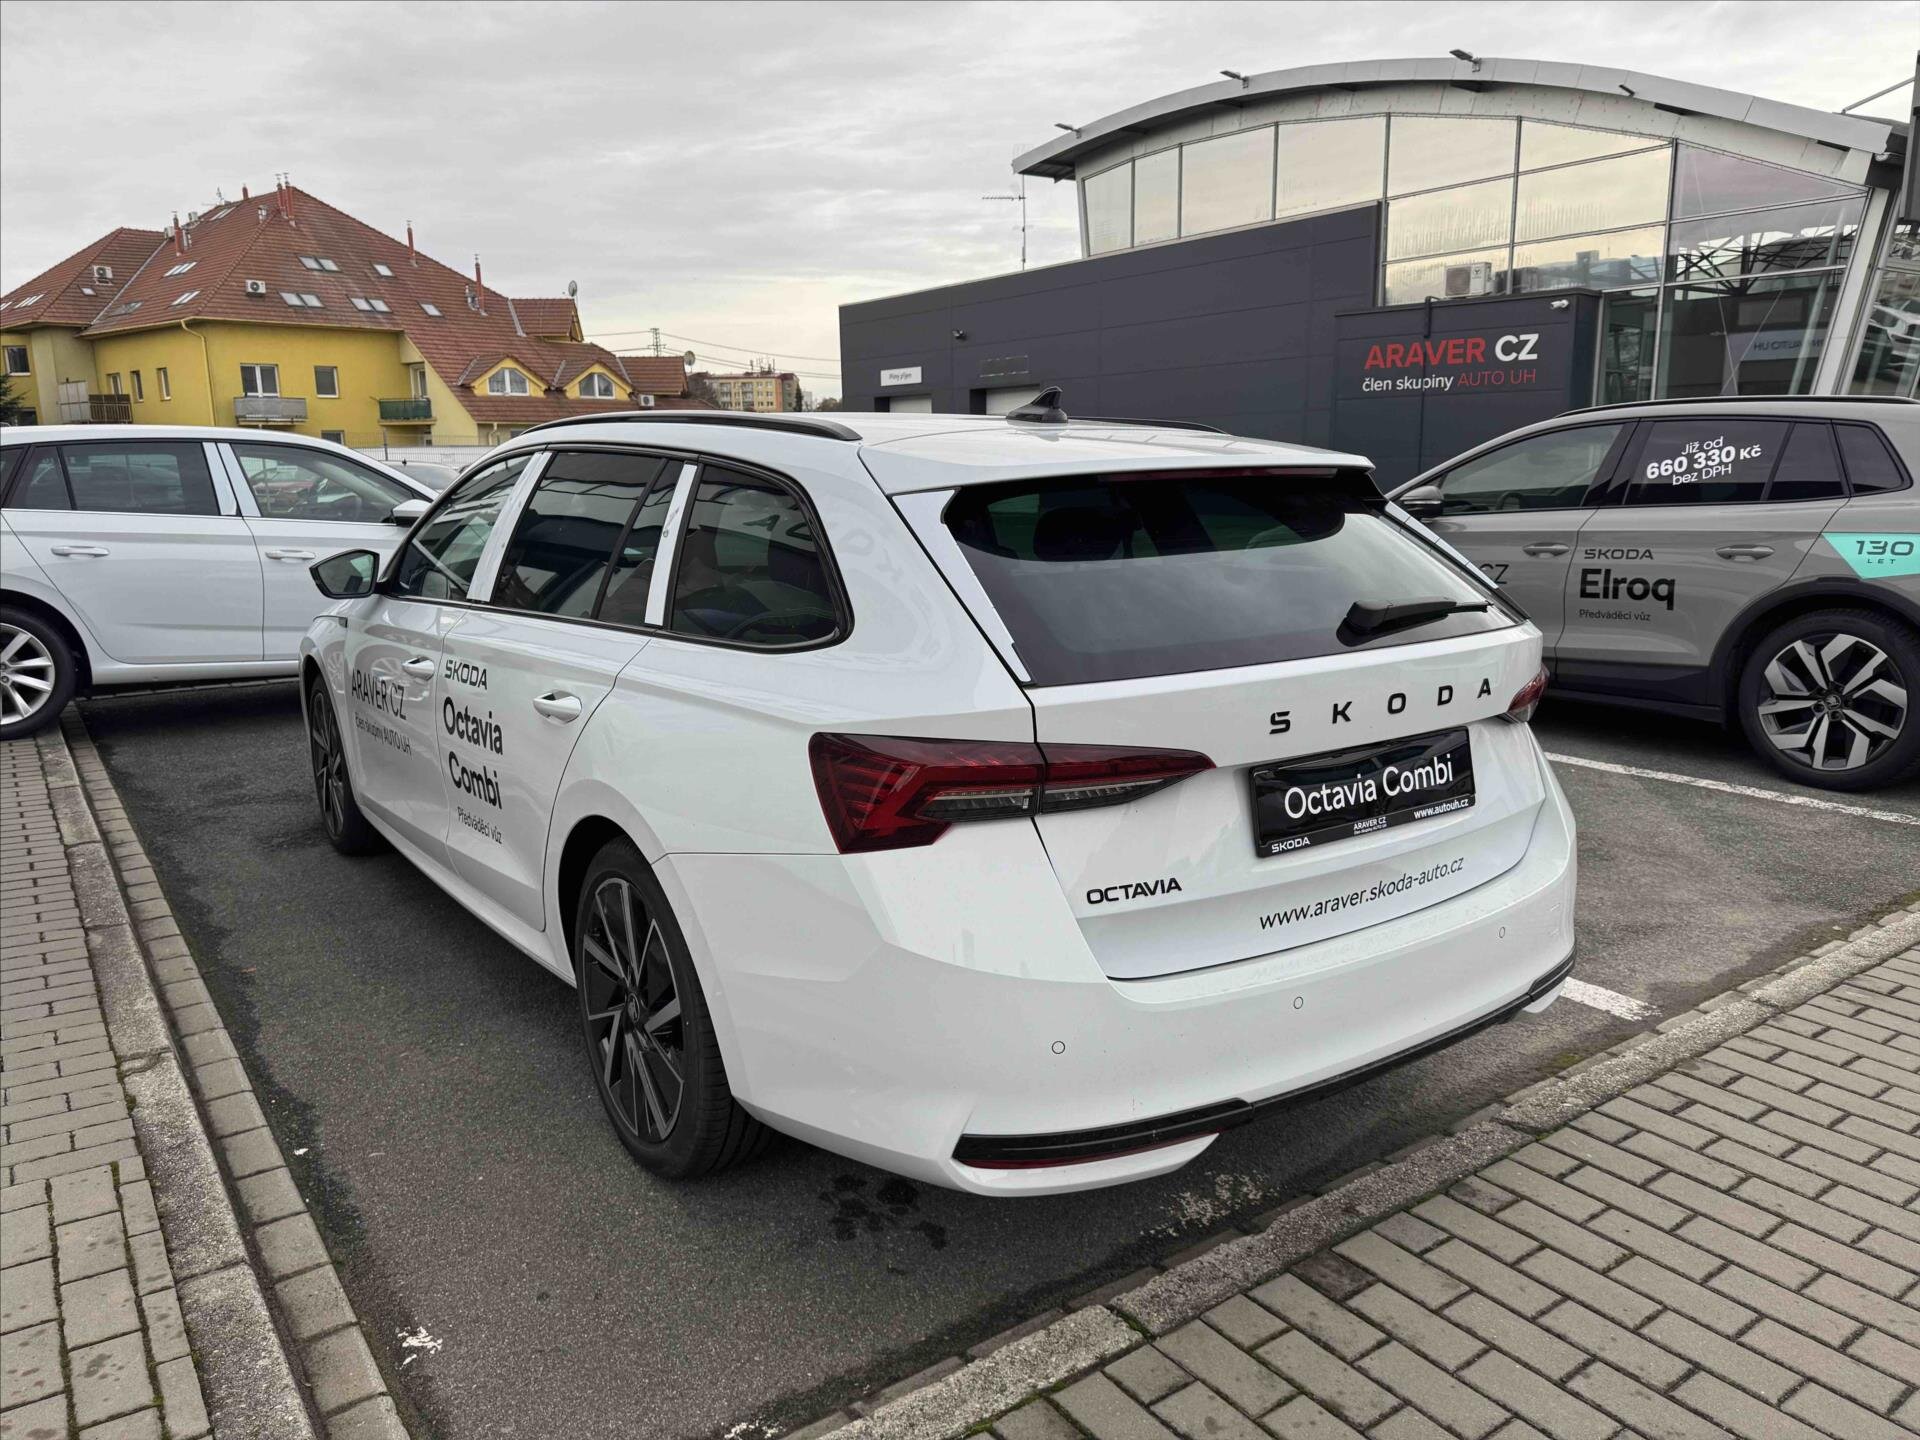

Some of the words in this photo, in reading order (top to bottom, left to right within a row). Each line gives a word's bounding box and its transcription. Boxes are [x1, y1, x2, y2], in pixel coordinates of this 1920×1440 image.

[1364, 337, 1486, 370] ARAVER
[1495, 333, 1540, 362] CZ
[1362, 376, 1392, 392] člen
[1396, 374, 1454, 392] skupiny
[1457, 371, 1505, 388] AUTO
[1510, 368, 1537, 385] UH
[1681, 441, 1699, 455] Již
[1703, 436, 1723, 450] od
[1646, 456, 1688, 479] 660
[1693, 446, 1736, 469] 330
[1672, 472, 1698, 486] bez
[1702, 463, 1732, 480] DPH
[1856, 541, 1915, 556] 130
[1580, 568, 1676, 611] Elroq
[352, 668, 389, 713] ARAVER
[390, 682, 407, 721] CZ
[443, 696, 503, 756] Octavia
[448, 751, 503, 810] Combi
[1284, 774, 1378, 819] Octavia
[1382, 753, 1454, 797] Combi
[1353, 818, 1377, 831] ARAVER
[1378, 816, 1387, 824] CZ
[1413, 798, 1470, 820] www.autouh.cz
[1086, 877, 1182, 905] OCTAVIA
[1259, 856, 1464, 930] www.araver.skoda-auto.cz
